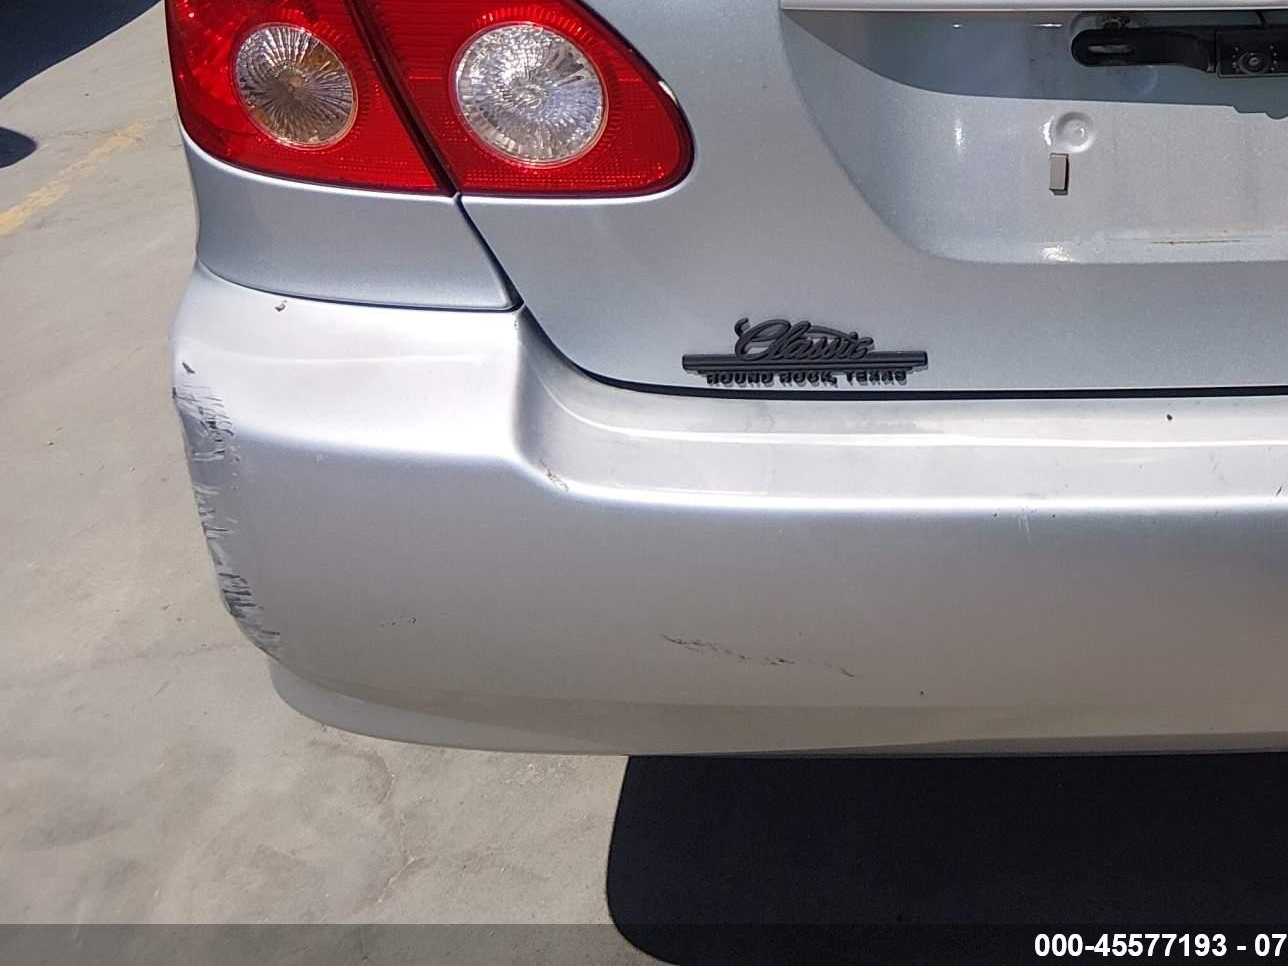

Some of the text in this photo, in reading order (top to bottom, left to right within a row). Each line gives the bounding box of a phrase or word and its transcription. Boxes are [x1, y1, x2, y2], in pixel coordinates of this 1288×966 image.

[734, 317, 874, 361] Classic
[706, 371, 774, 386] ROUND
[845, 369, 908, 385] TEXAS
